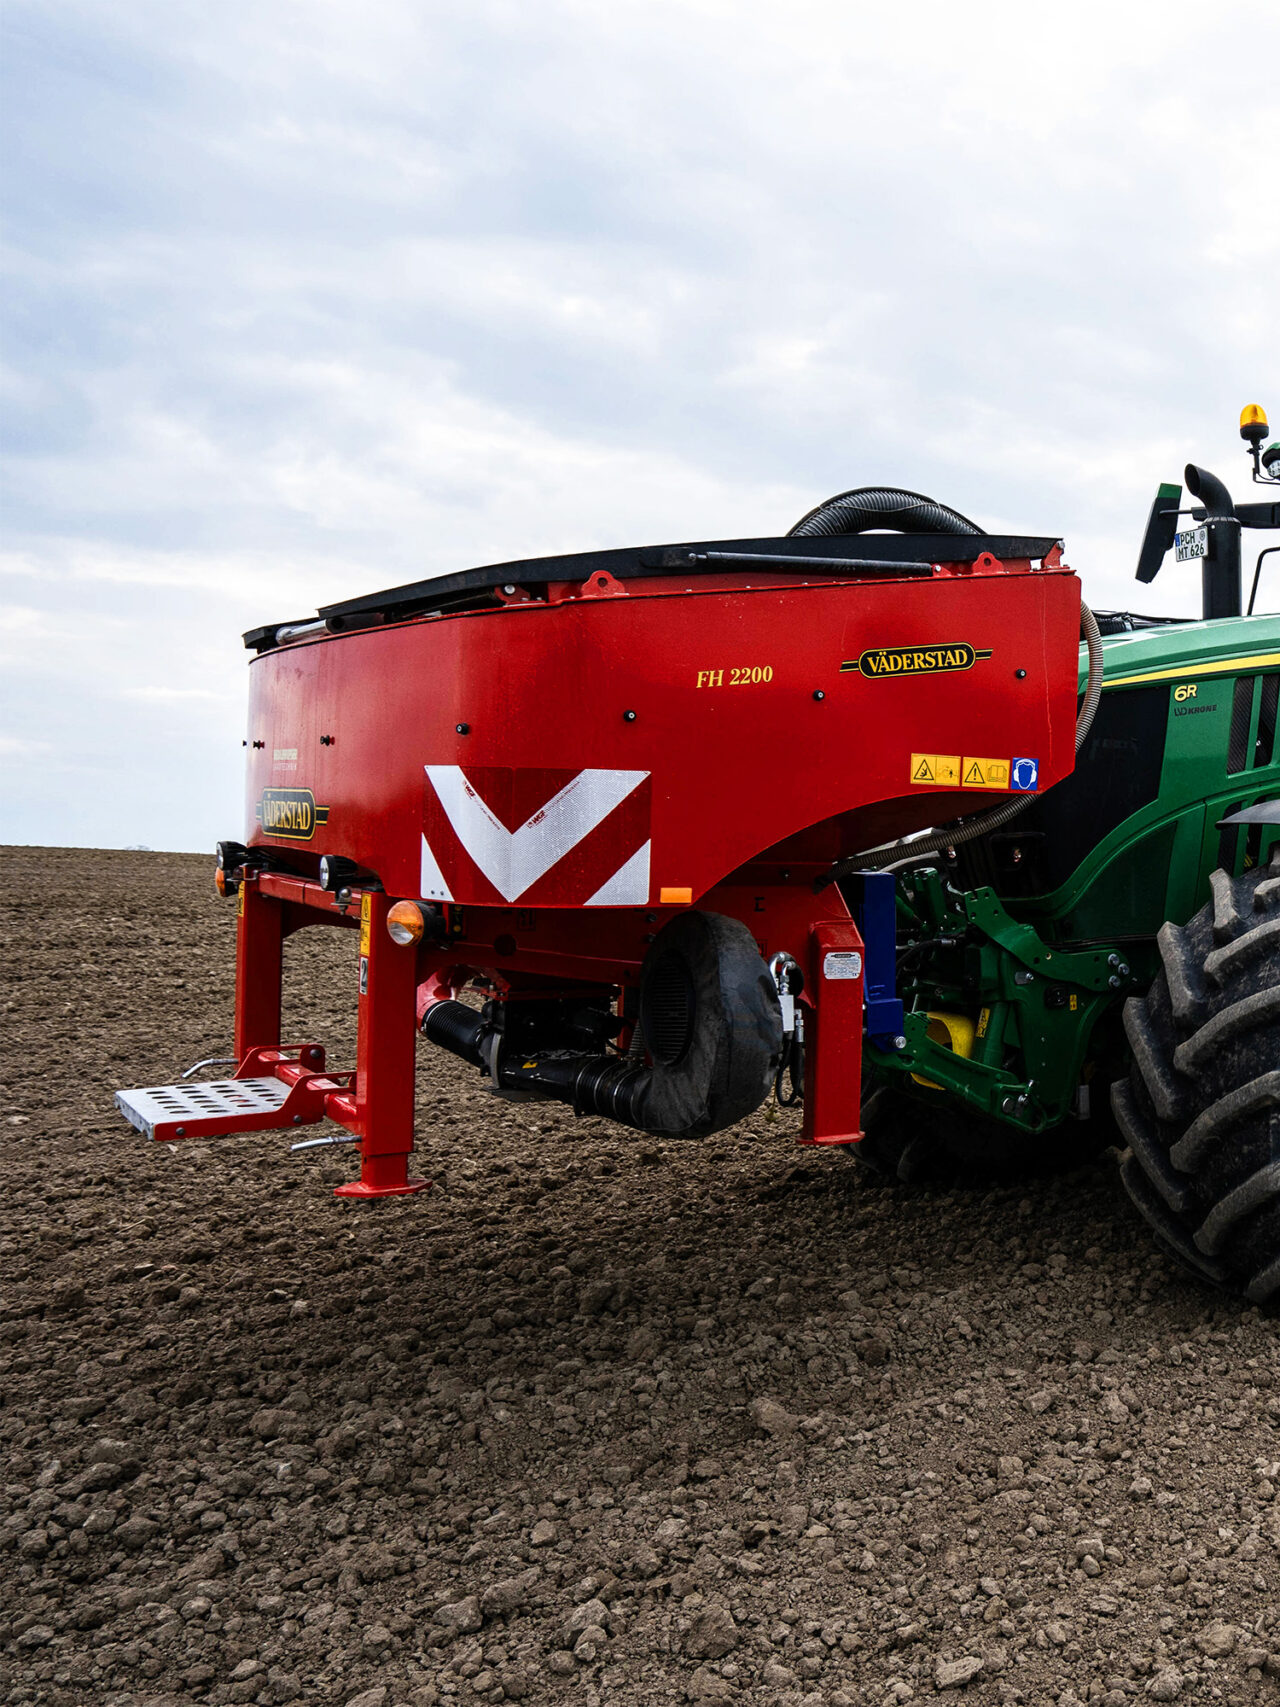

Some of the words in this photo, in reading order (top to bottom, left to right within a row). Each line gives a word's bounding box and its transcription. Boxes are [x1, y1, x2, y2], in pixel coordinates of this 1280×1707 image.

[1180, 531, 1195, 545] PCH
[1178, 546, 1188, 560] MT
[1190, 543, 1205, 556] 626
[867, 648, 969, 674] VÄDERSTAD
[696, 670, 724, 689] FH
[729, 665, 773, 687] 2200
[1174, 684, 1198, 702] 6R
[361, 960, 368, 987] 2
